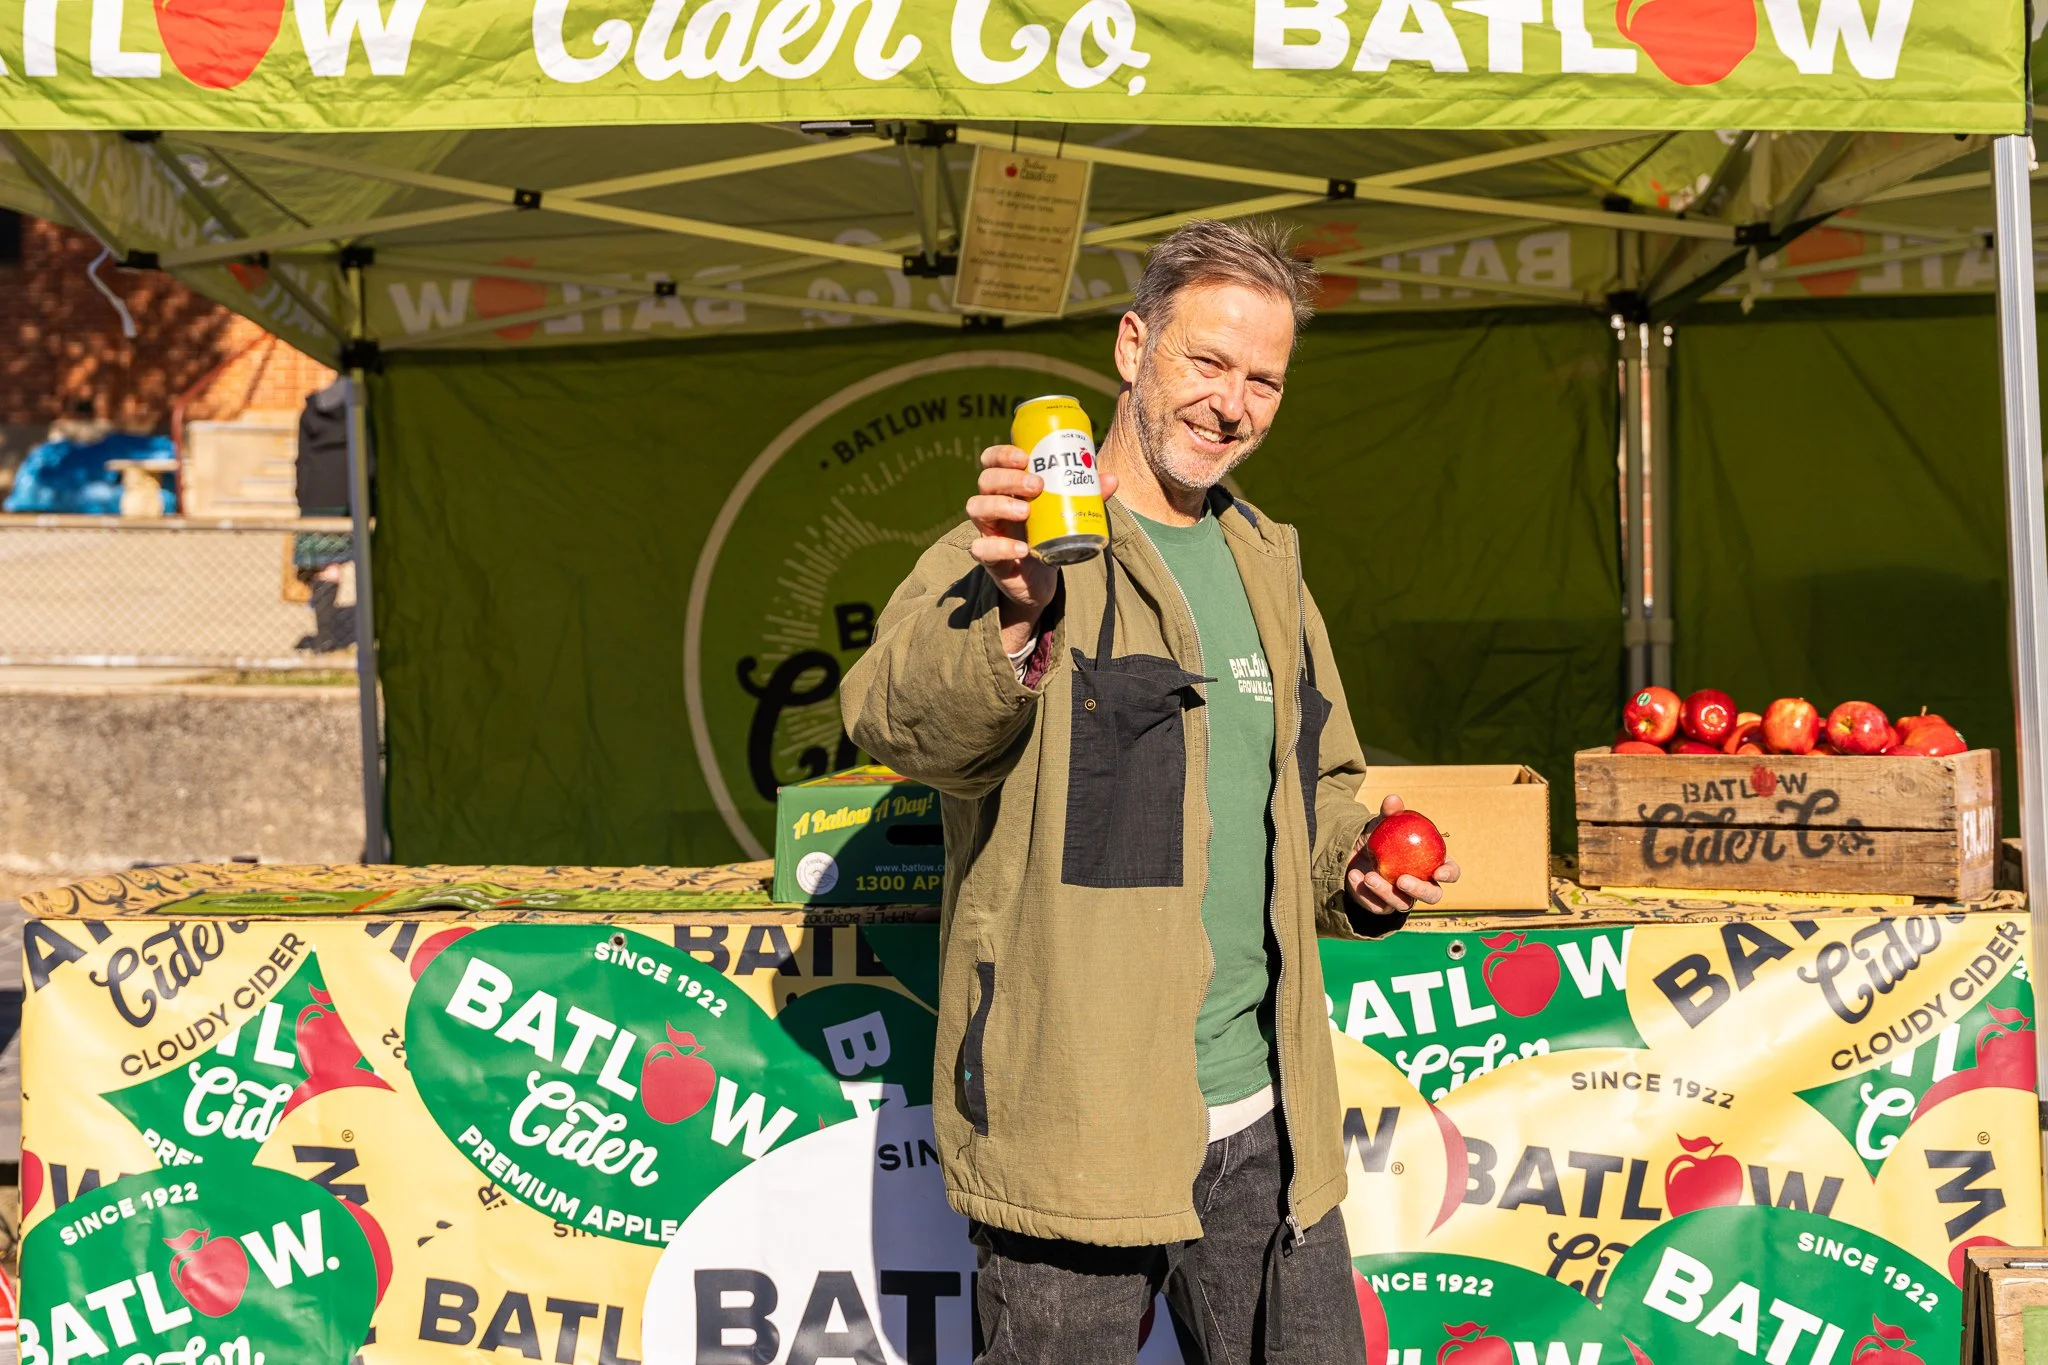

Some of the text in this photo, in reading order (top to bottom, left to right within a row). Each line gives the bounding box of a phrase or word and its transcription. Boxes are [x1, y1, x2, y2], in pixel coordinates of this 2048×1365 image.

[532, 0, 922, 83] Cider
[831, 392, 1020, 465] BATLOW SIN
[793, 812, 810, 840] A
[811, 806, 872, 834] Batlow
[892, 792, 934, 818] Day!
[1638, 802, 1787, 870] Cider
[856, 875, 906, 891] 1300
[120, 1003, 229, 1077] CLOUDY
[232, 932, 306, 1011] CIDER
[594, 941, 728, 1018] SINCE 1922
[1830, 995, 1949, 1072] CLOUDY
[1950, 921, 2027, 1002] CIDER
[1571, 1071, 1735, 1110] SINCE 1922
[508, 1070, 660, 1188] Cider
[877, 1139, 940, 1172] SIN
[59, 1198, 137, 1247] SINCE
[140, 1181, 200, 1211] 1922
[458, 1124, 581, 1224] PREMIUM
[580, 1205, 680, 1244] APPLE
[1436, 1273, 1494, 1298] 1922
[1797, 1232, 1940, 1313] SINCE 1922
